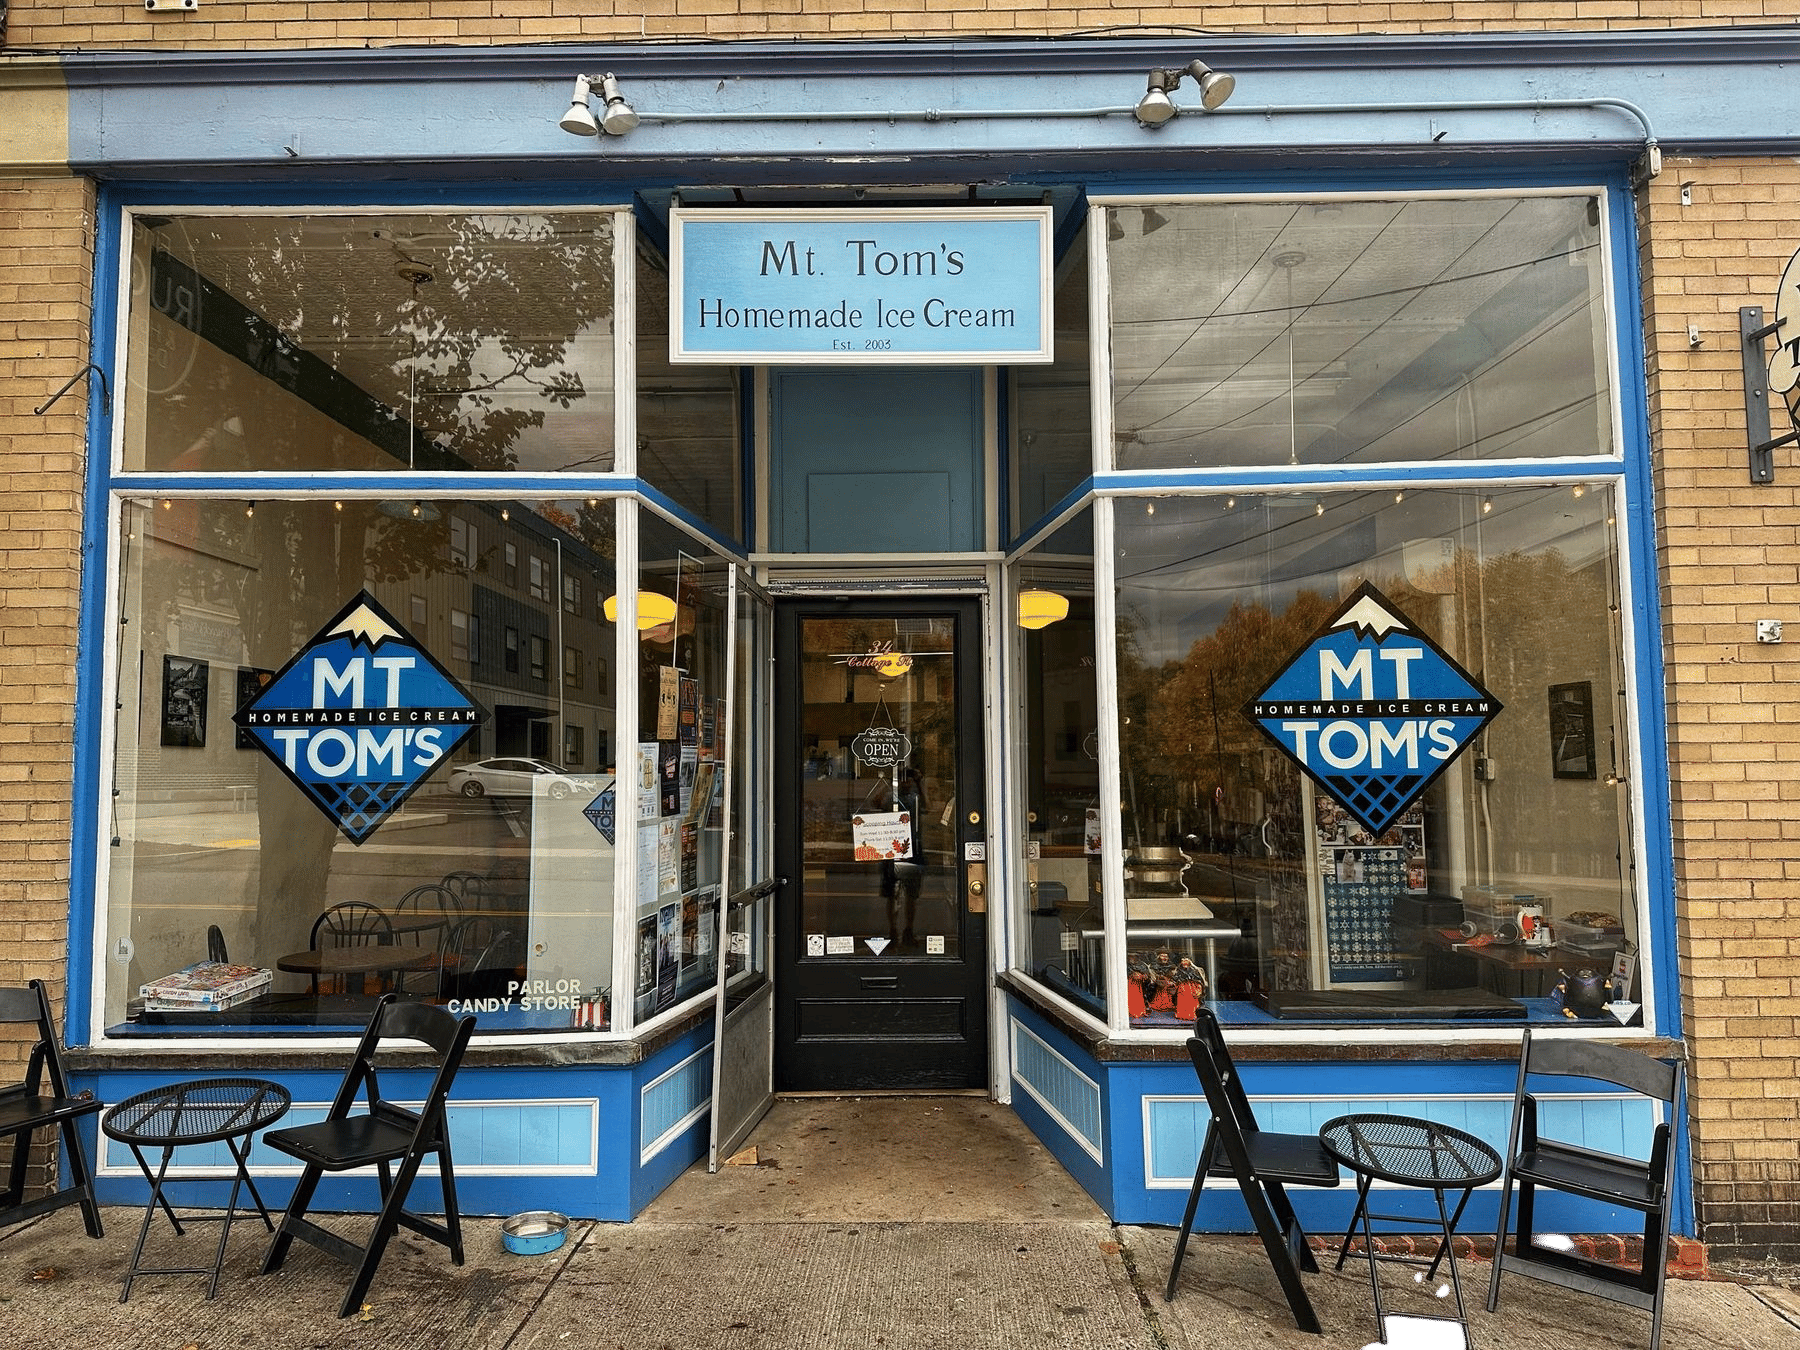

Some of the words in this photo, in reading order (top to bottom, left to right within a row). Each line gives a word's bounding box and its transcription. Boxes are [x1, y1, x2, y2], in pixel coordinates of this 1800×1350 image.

[760, 240, 824, 276] Mt.
[846, 239, 965, 276] Tom's
[699, 298, 863, 328] Homemade
[877, 298, 915, 328] Ice
[923, 298, 1016, 328] Cream
[832, 339, 855, 350] Est.
[864, 339, 892, 350] 2003
[868, 640, 893, 655] 34
[313, 657, 415, 709] MT
[1319, 648, 1423, 701] MT
[249, 711, 355, 723] HOMEMADE
[368, 711, 401, 722] ICE
[410, 711, 477, 722] CREAM
[1254, 704, 1365, 714] HOMEMADE
[1378, 704, 1411, 713] ICE
[1425, 703, 1490, 713] CREAM
[273, 727, 443, 777] TOM'S
[864, 743, 899, 756] OPEN
[1282, 719, 1458, 769] TOM'S
[507, 979, 581, 996] PARLOR
[448, 998, 511, 1014] CANDY
[519, 996, 581, 1012] STORE
